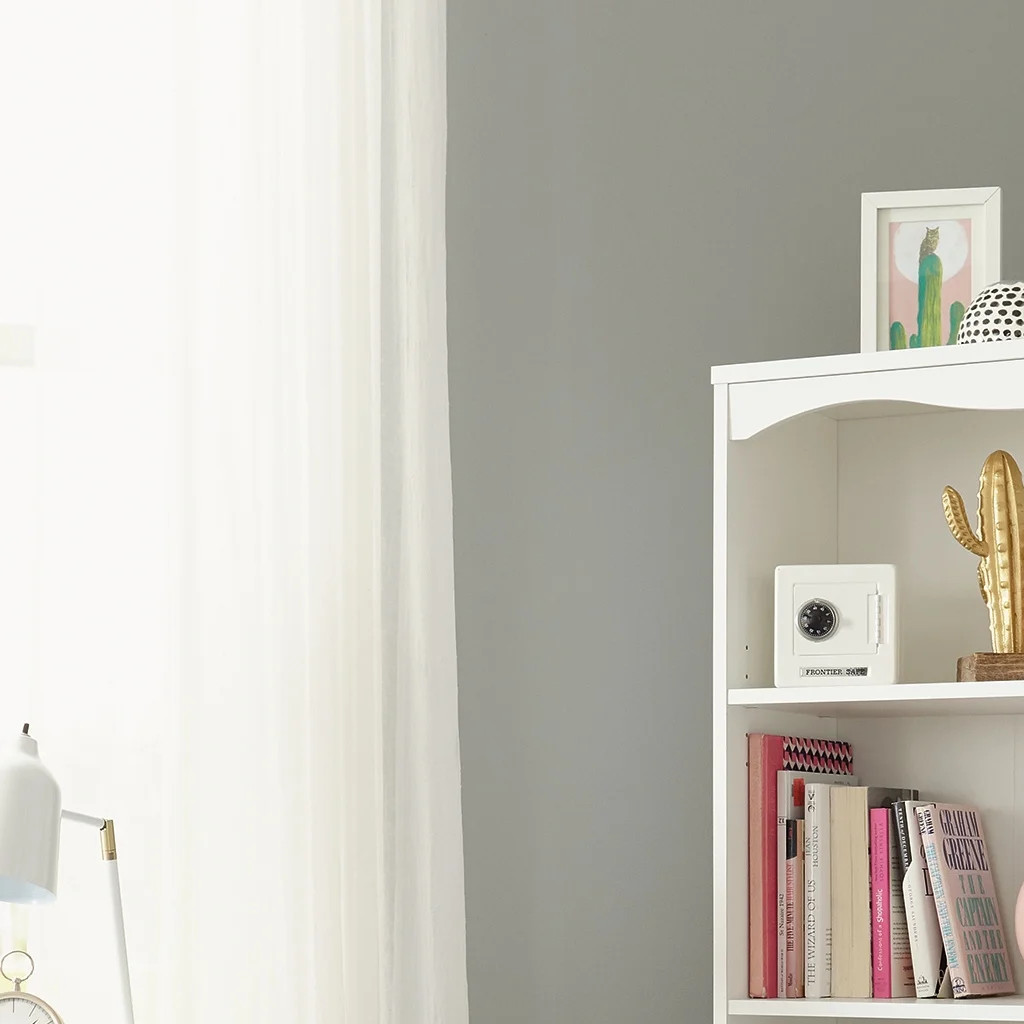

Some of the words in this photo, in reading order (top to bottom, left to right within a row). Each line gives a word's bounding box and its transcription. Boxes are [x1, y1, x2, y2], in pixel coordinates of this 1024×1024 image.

[939, 810, 980, 837] GRAHAM
[942, 838, 988, 870] GREENE
[808, 879, 816, 894] US
[958, 874, 985, 894] THE
[808, 898, 816, 913] OF
[956, 897, 999, 927] CAPTAIN
[808, 915, 816, 961] WIZARD
[963, 930, 982, 951] AND
[983, 930, 1004, 950] THE
[808, 964, 816, 985] THE
[967, 953, 1009, 984] ENEMY
